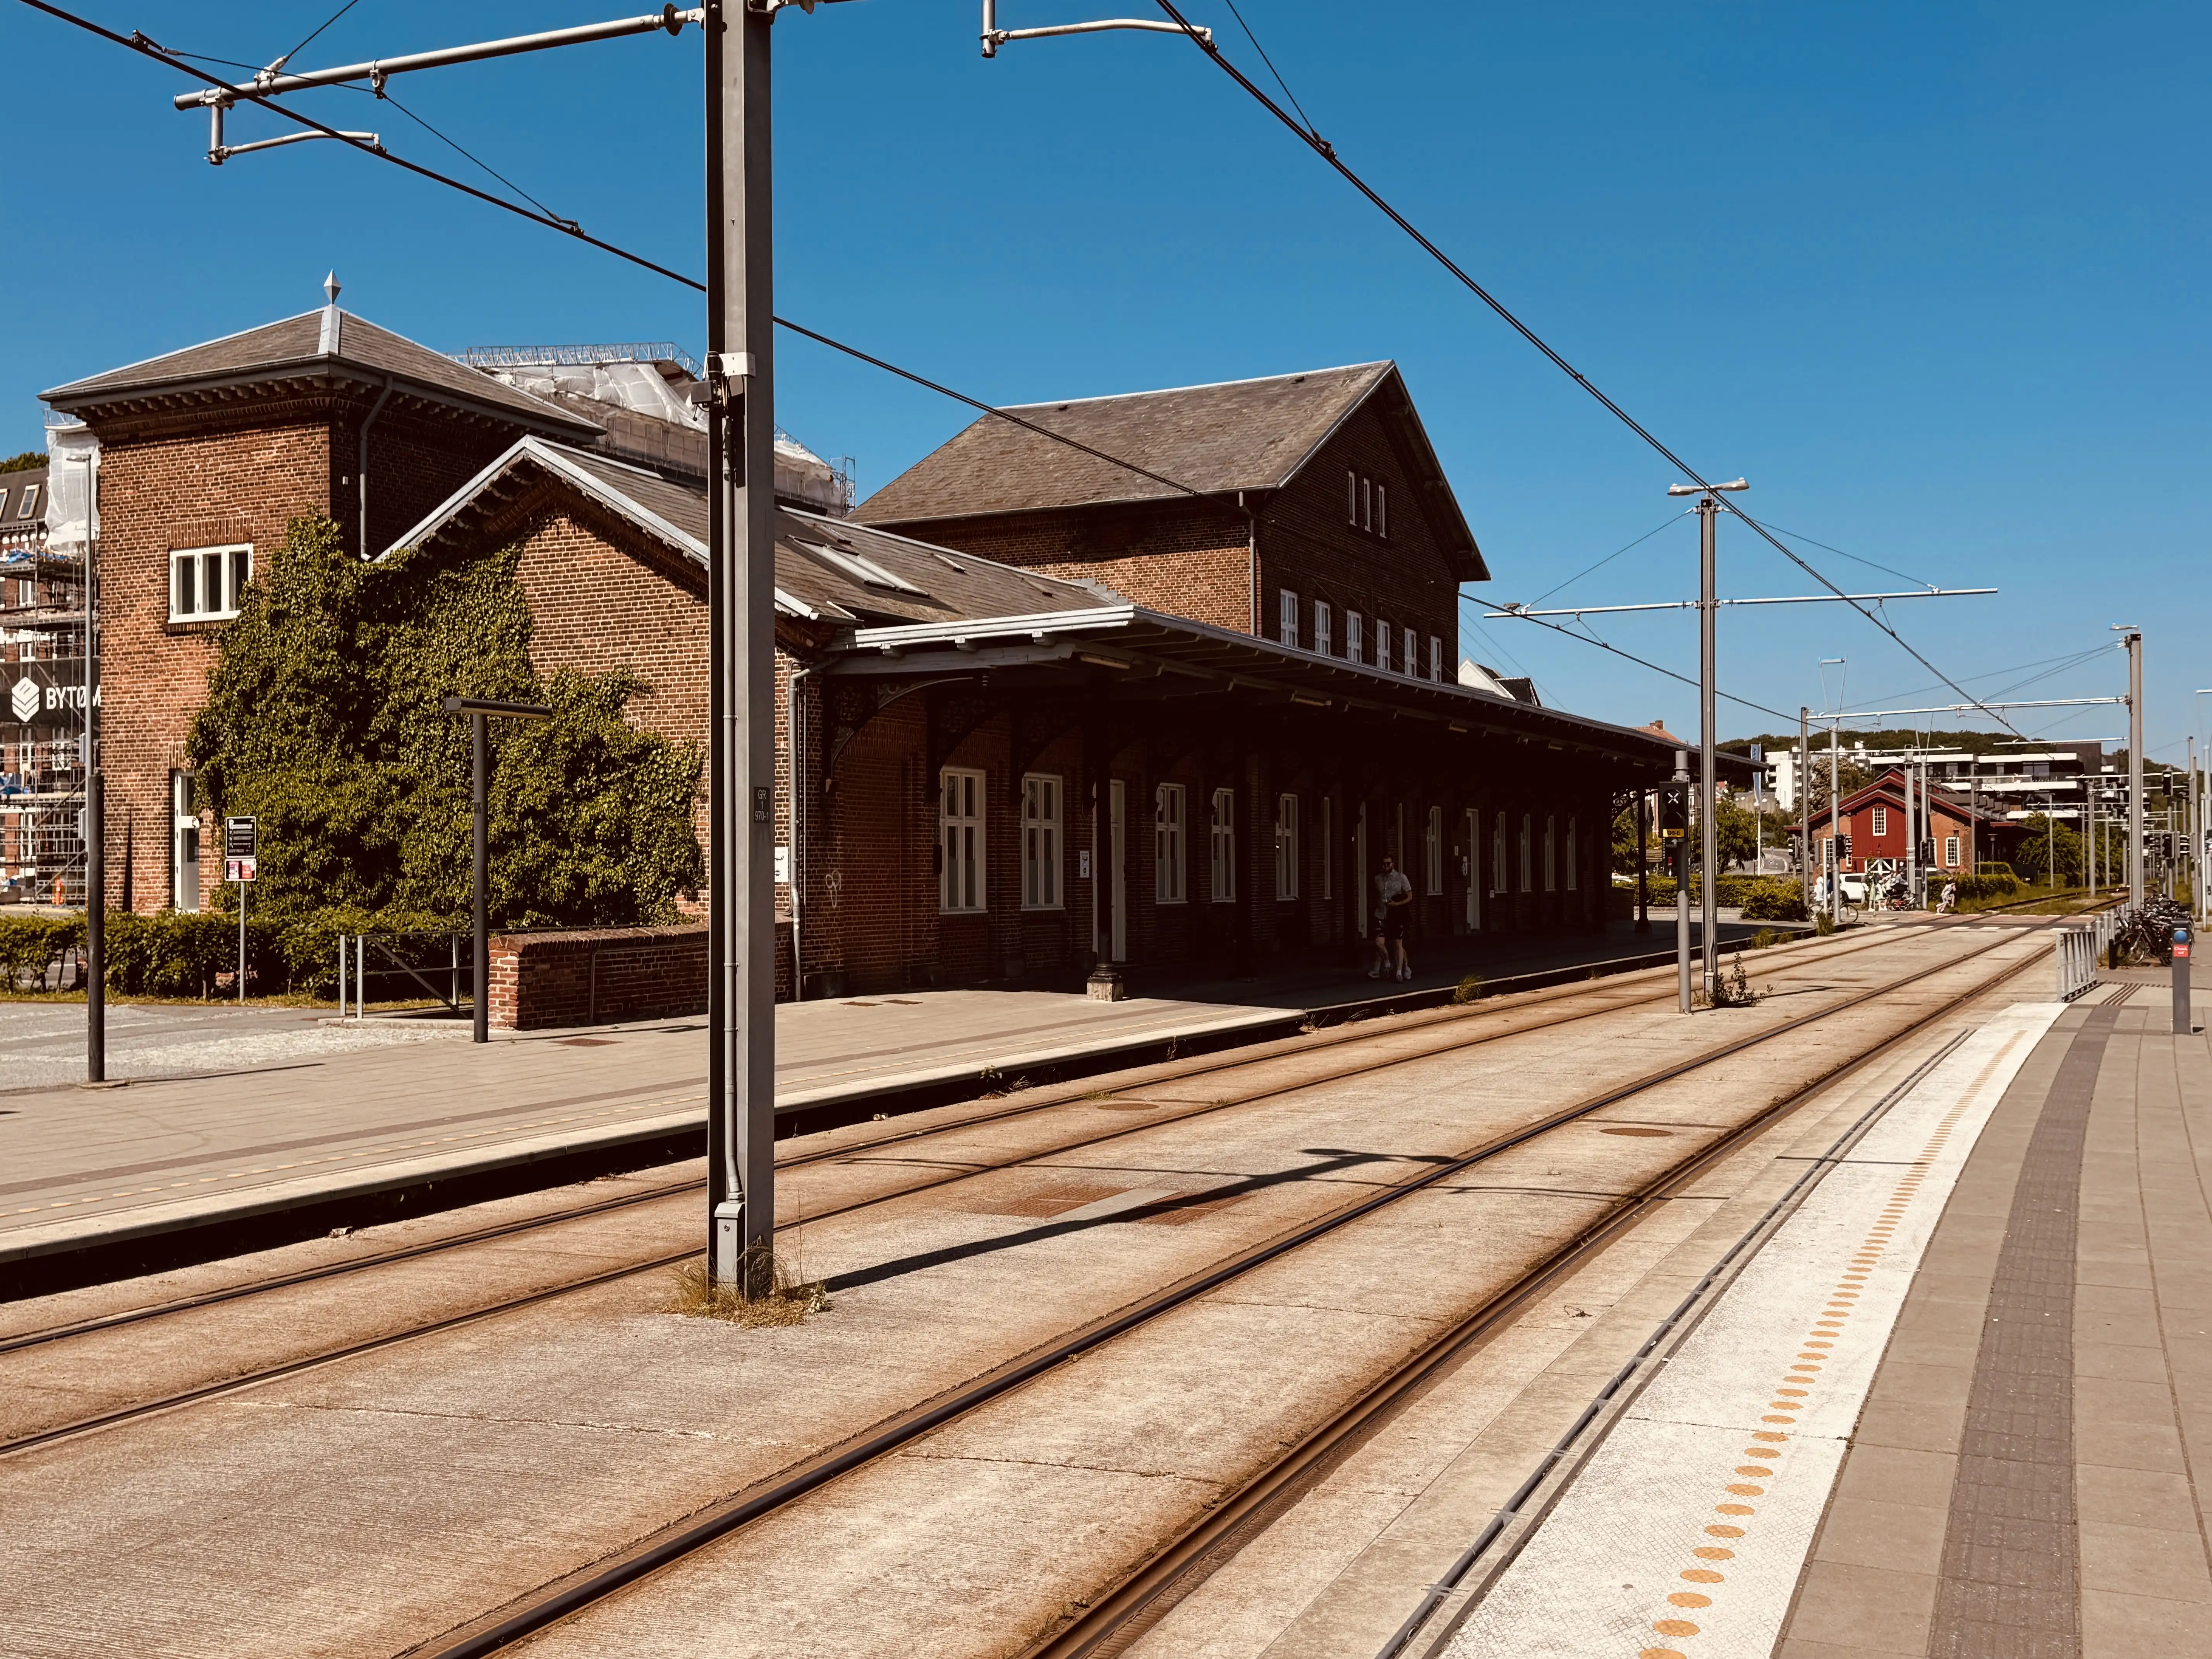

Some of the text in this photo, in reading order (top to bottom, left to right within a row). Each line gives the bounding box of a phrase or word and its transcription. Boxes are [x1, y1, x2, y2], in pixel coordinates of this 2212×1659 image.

[758, 789, 766, 799] GR
[761, 800, 763, 810] 1
[755, 811, 769, 821] 970-1
